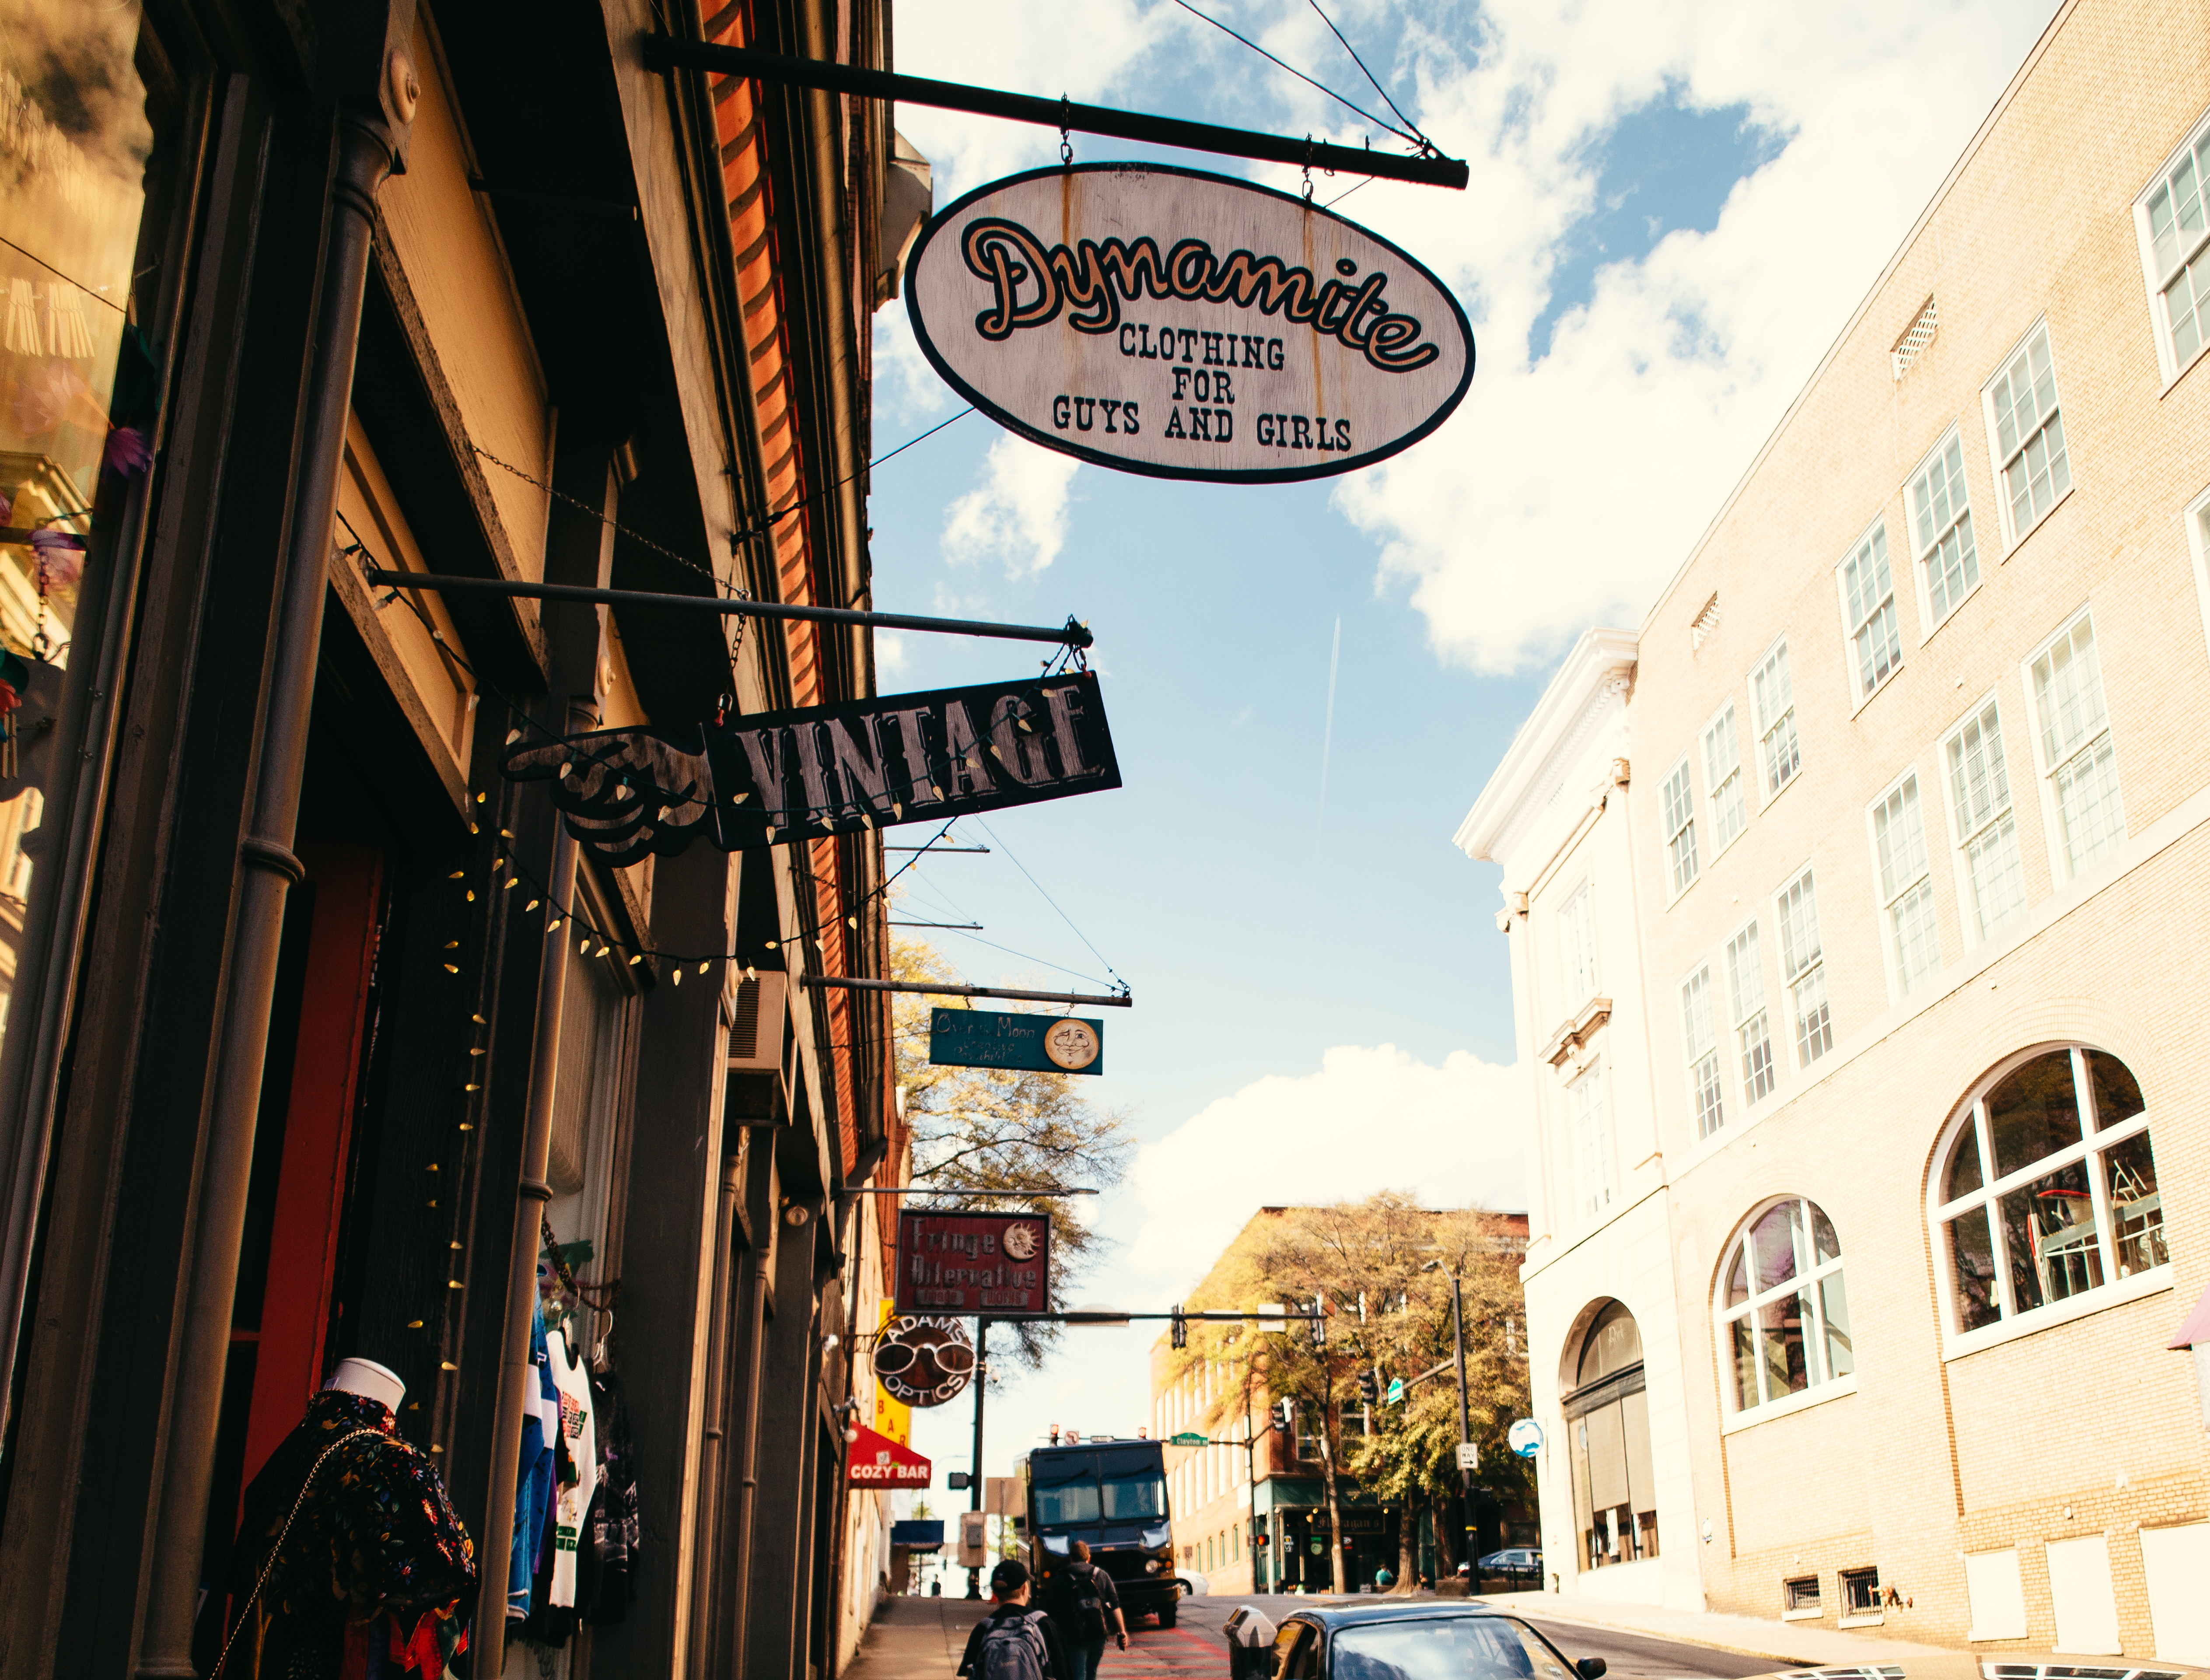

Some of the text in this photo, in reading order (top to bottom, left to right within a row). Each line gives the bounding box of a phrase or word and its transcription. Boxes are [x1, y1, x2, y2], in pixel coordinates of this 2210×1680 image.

[962, 217, 1439, 373] Dynamite
[1119, 322, 1286, 371] CLOTHING
[1171, 366, 1235, 405] FOR
[1052, 395, 1352, 452] GUYS AND GIRLS
[735, 685, 1107, 830] VINTAGE
[997, 1015, 1036, 1039] Moon
[912, 1218, 995, 1261] Fringe
[911, 1253, 1037, 1289] Alternative
[886, 1316, 967, 1344] ADAMS
[885, 1374, 964, 1405] OPTICS
[1177, 1438, 1200, 1446] Clayton
[850, 1465, 929, 1479] COZY BAR
